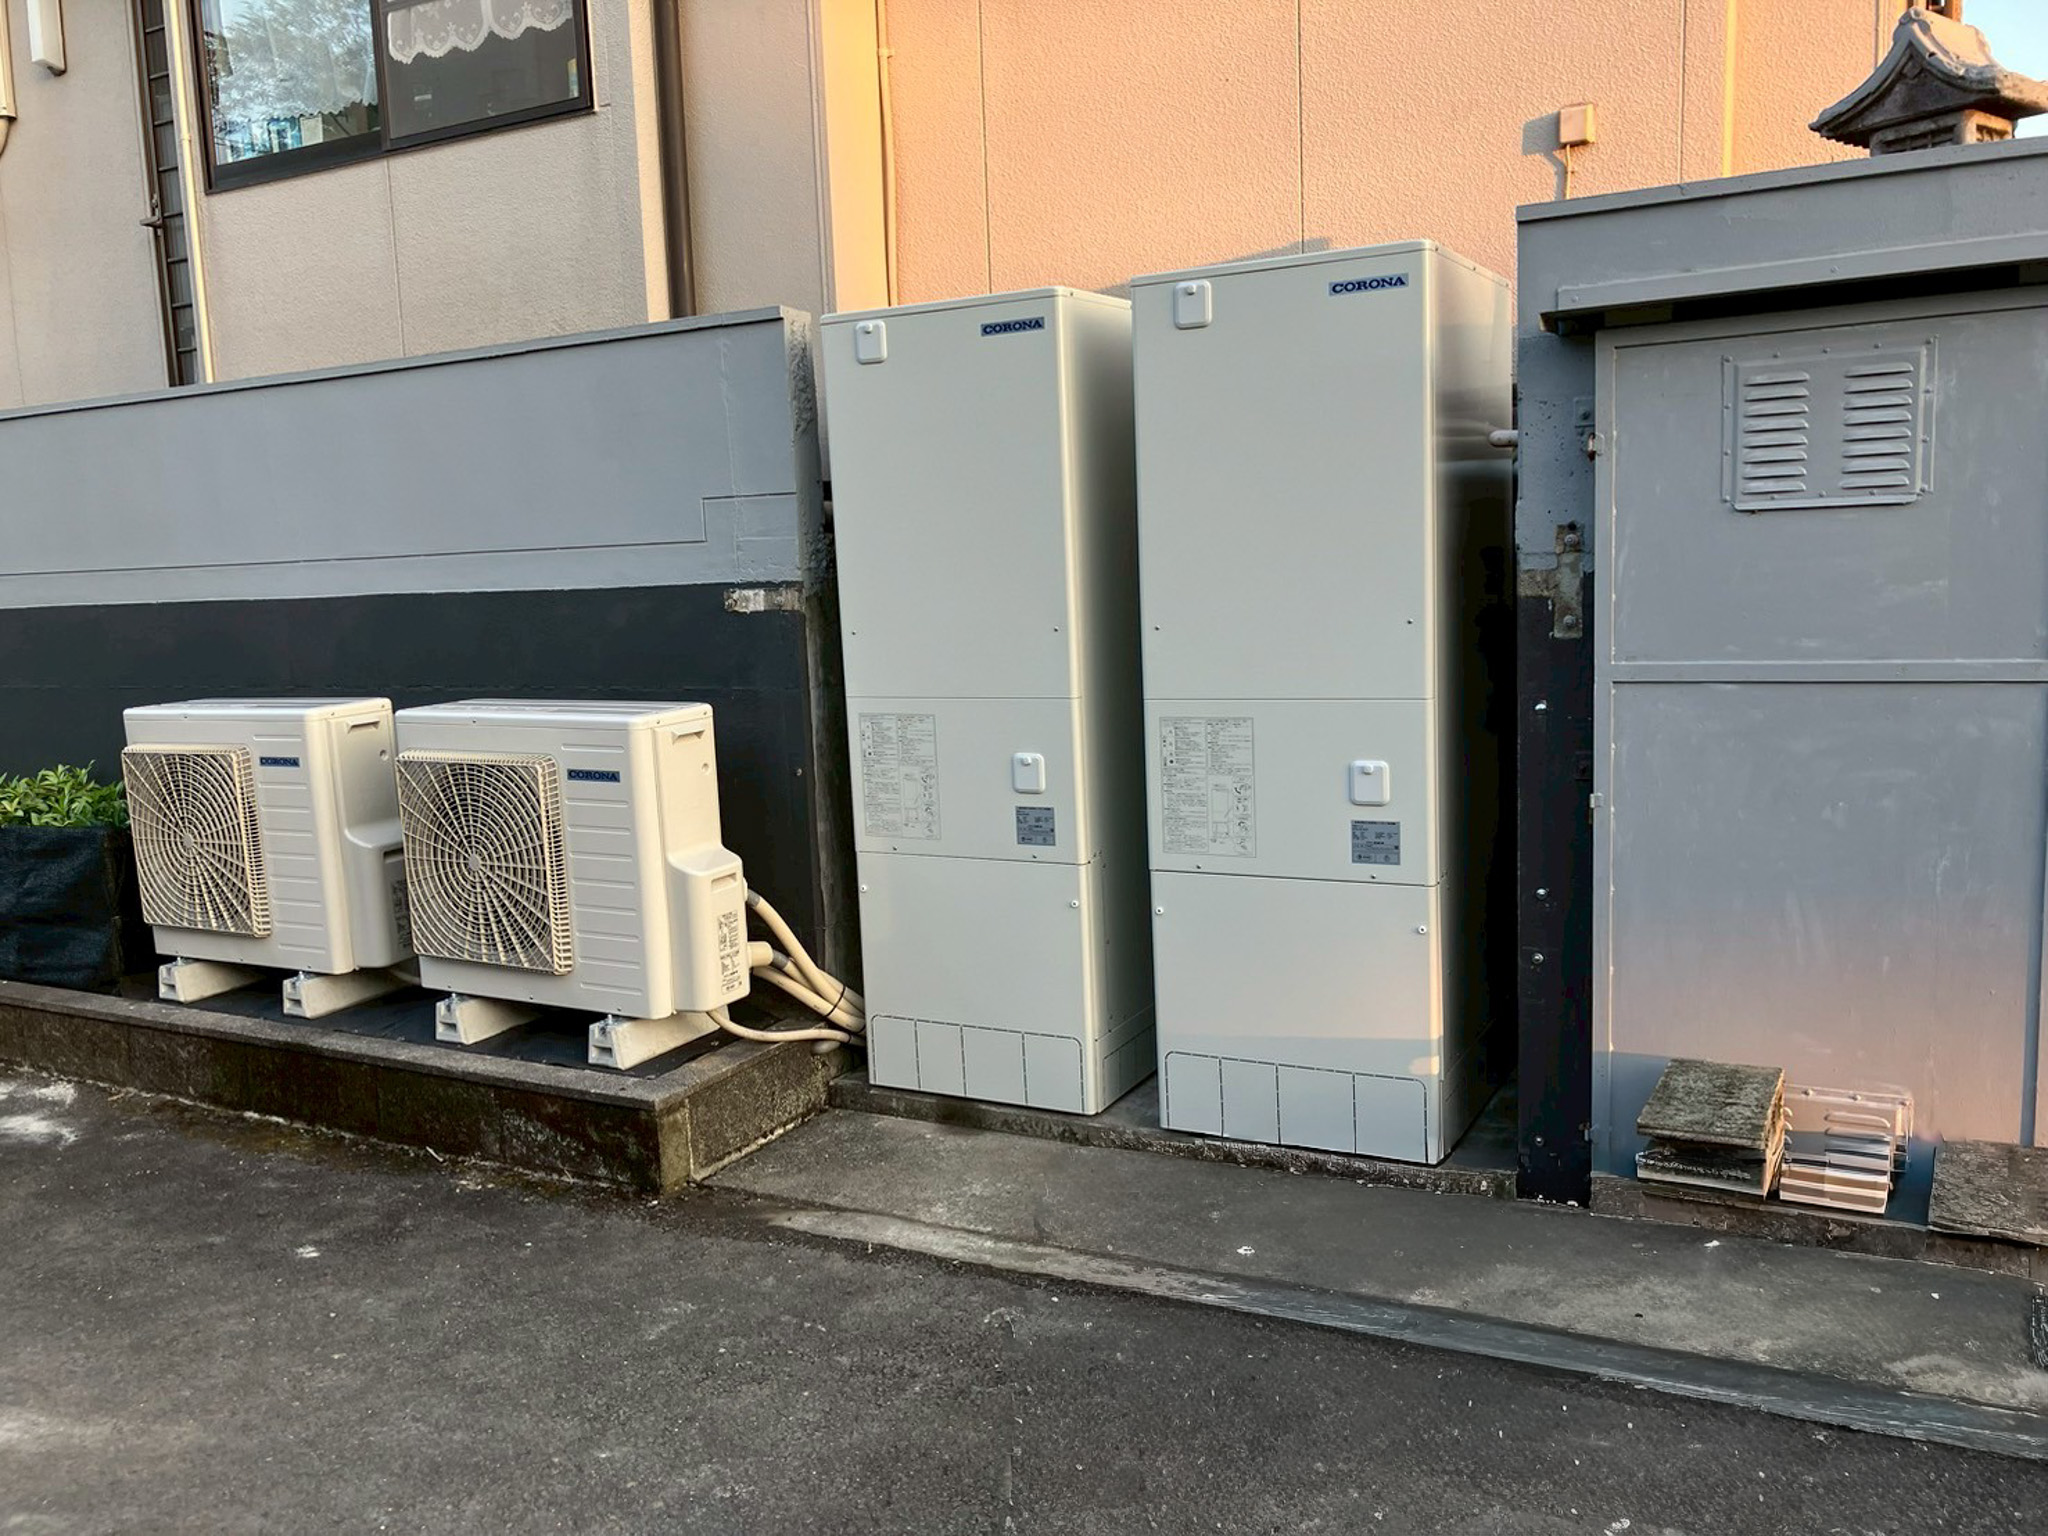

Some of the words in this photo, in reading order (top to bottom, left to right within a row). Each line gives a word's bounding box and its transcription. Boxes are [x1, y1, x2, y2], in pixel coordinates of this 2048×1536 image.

[1332, 276, 1406, 294] CORONA
[984, 319, 1042, 335] CORONA
[569, 770, 618, 781] CORONA
